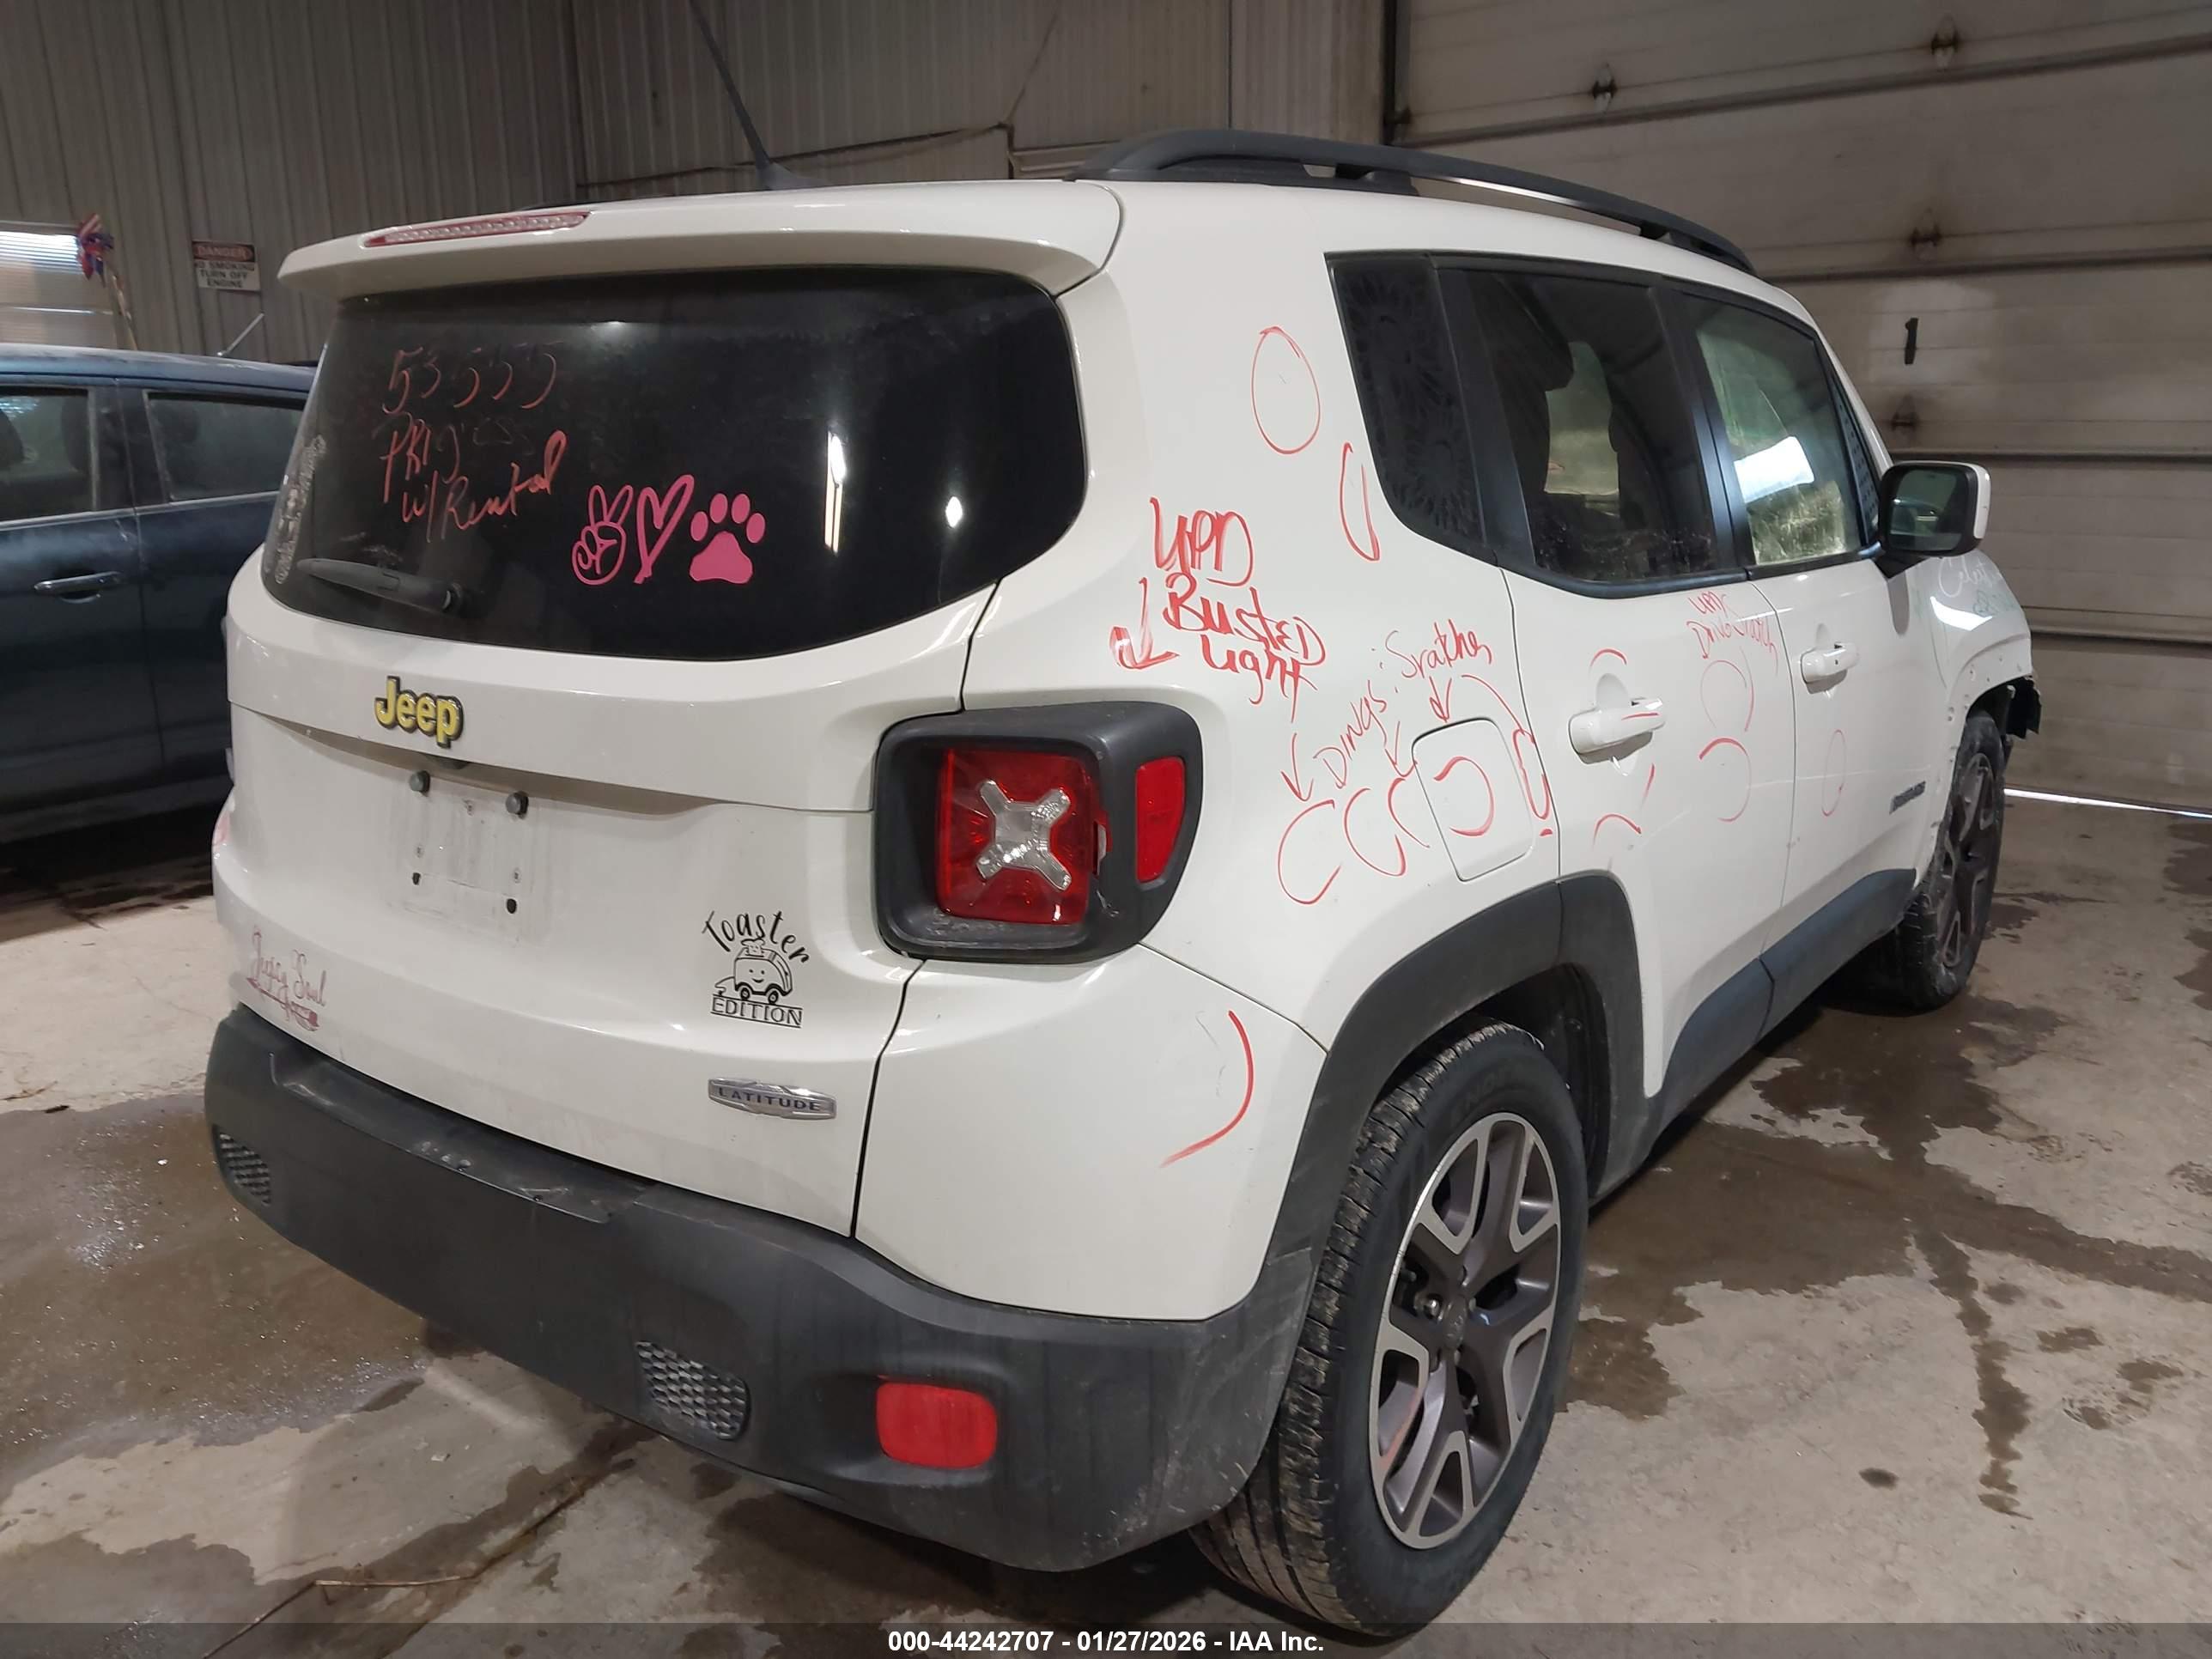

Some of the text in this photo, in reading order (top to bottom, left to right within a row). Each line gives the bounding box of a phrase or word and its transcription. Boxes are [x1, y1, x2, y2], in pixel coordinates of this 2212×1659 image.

[198, 246, 249, 259] DANGER
[199, 269, 248, 279] TURN OFF
[209, 261, 255, 271] SMOKING
[207, 277, 244, 288] ENGINE
[374, 675, 465, 749] Jeep
[701, 910, 810, 963] Toaster
[712, 997, 803, 1026] EDITION
[718, 1086, 822, 1112] LATITUDE
